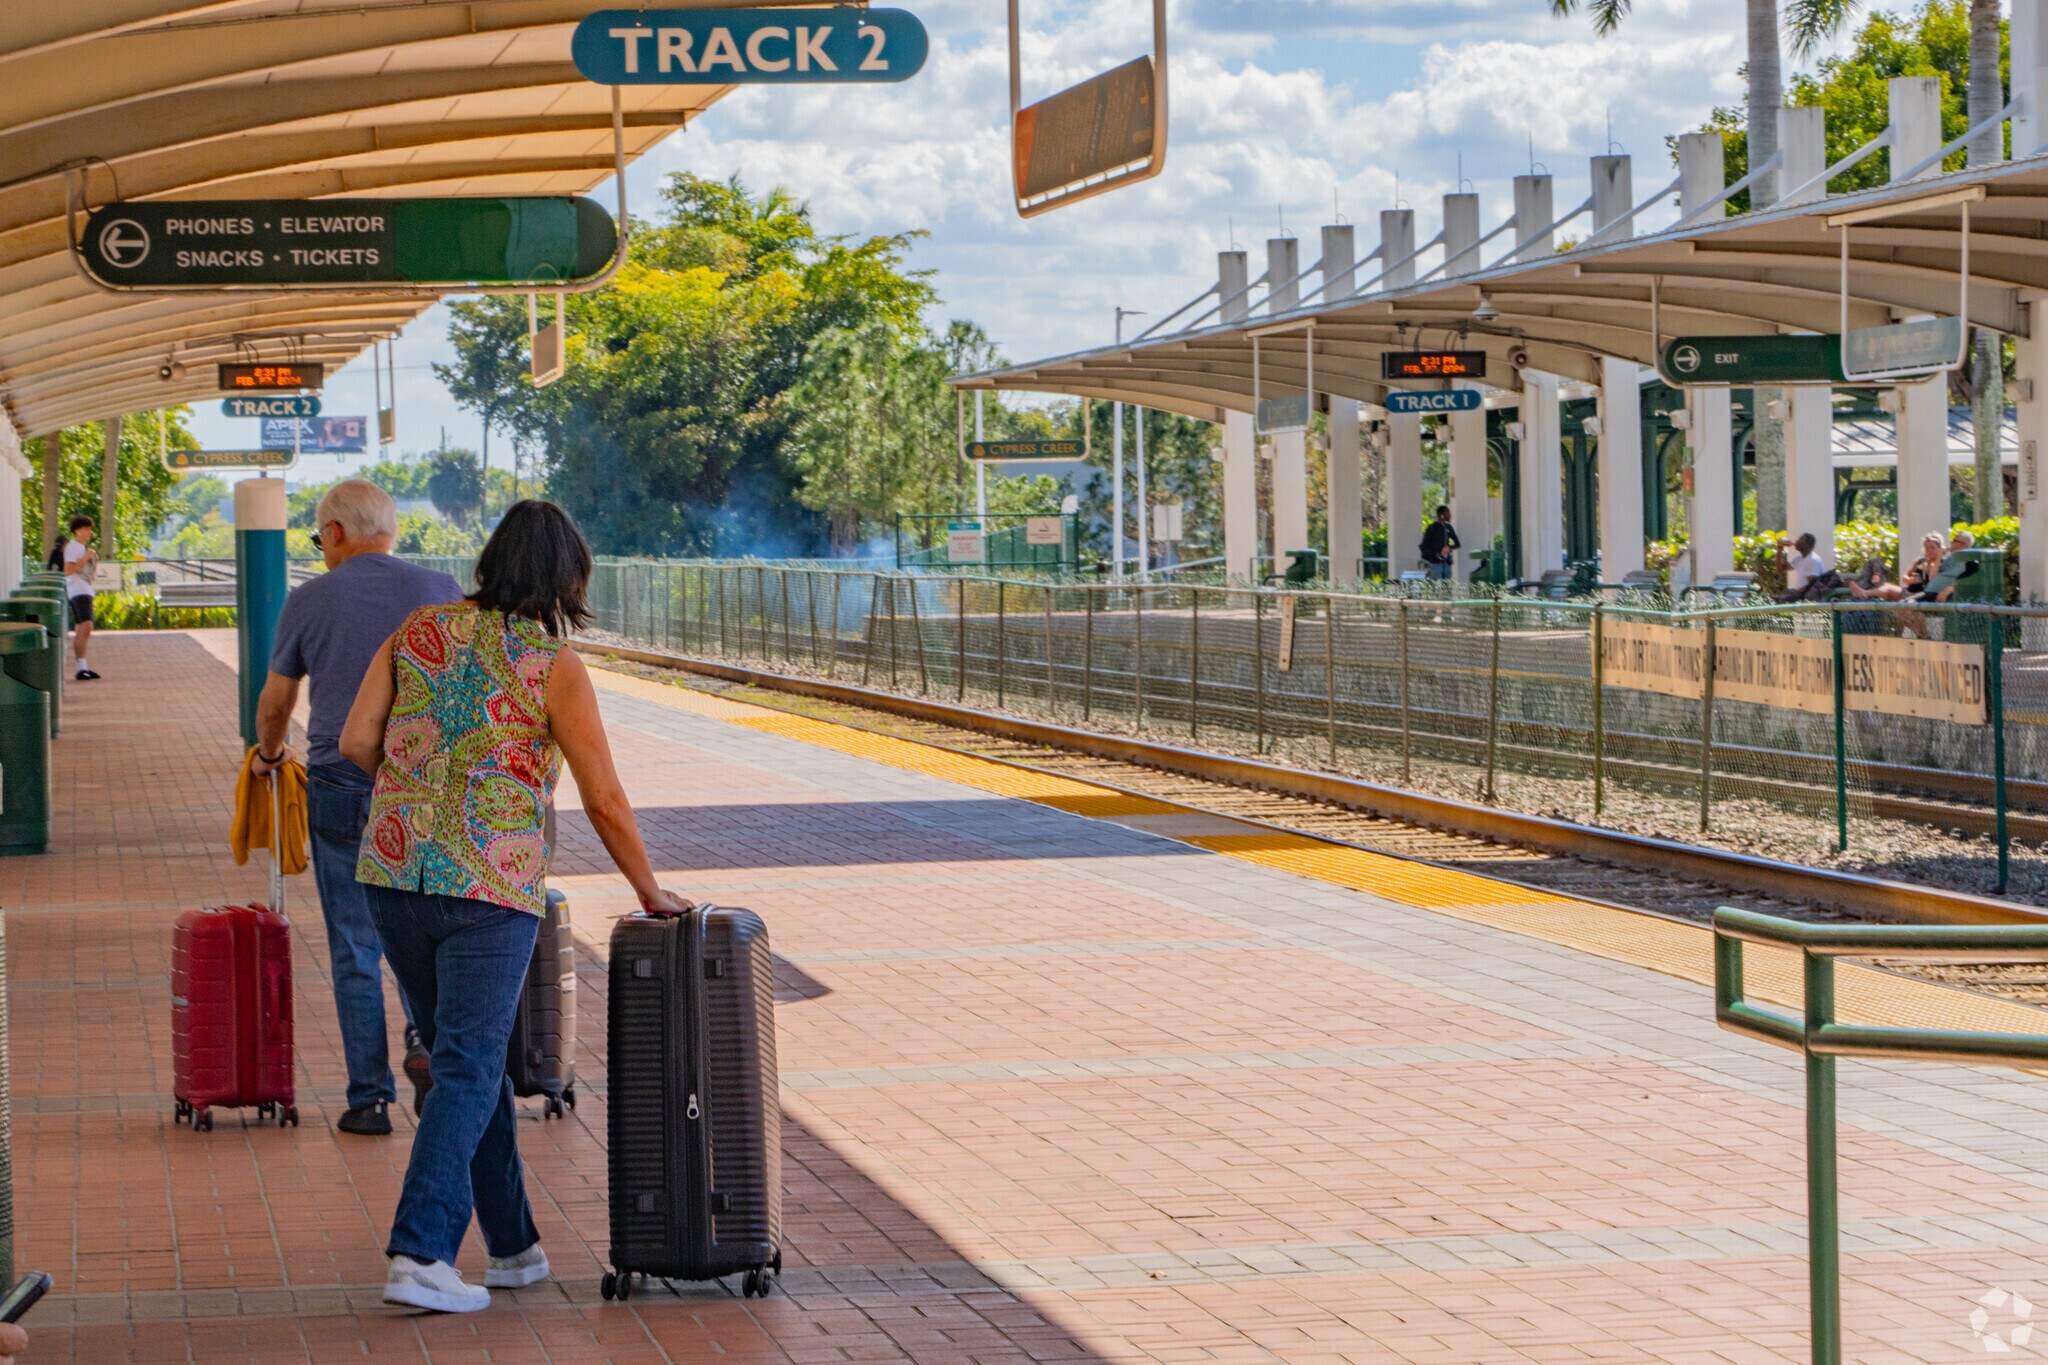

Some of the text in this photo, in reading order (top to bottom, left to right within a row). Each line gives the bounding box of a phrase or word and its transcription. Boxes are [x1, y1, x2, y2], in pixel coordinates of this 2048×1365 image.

[608, 25, 889, 73] TRACK 2
[166, 216, 385, 235] PHONES ELEVATOR
[176, 248, 380, 268] SNACKS TICKETS
[1443, 356, 1456, 364] PM
[1714, 353, 1739, 364] EXIT
[231, 401, 312, 416] TRACK 2
[1395, 394, 1457, 410] TRACK
[990, 443, 1077, 455] CYPRESS CREEK
[193, 451, 286, 464] CYPRESS CREEK
